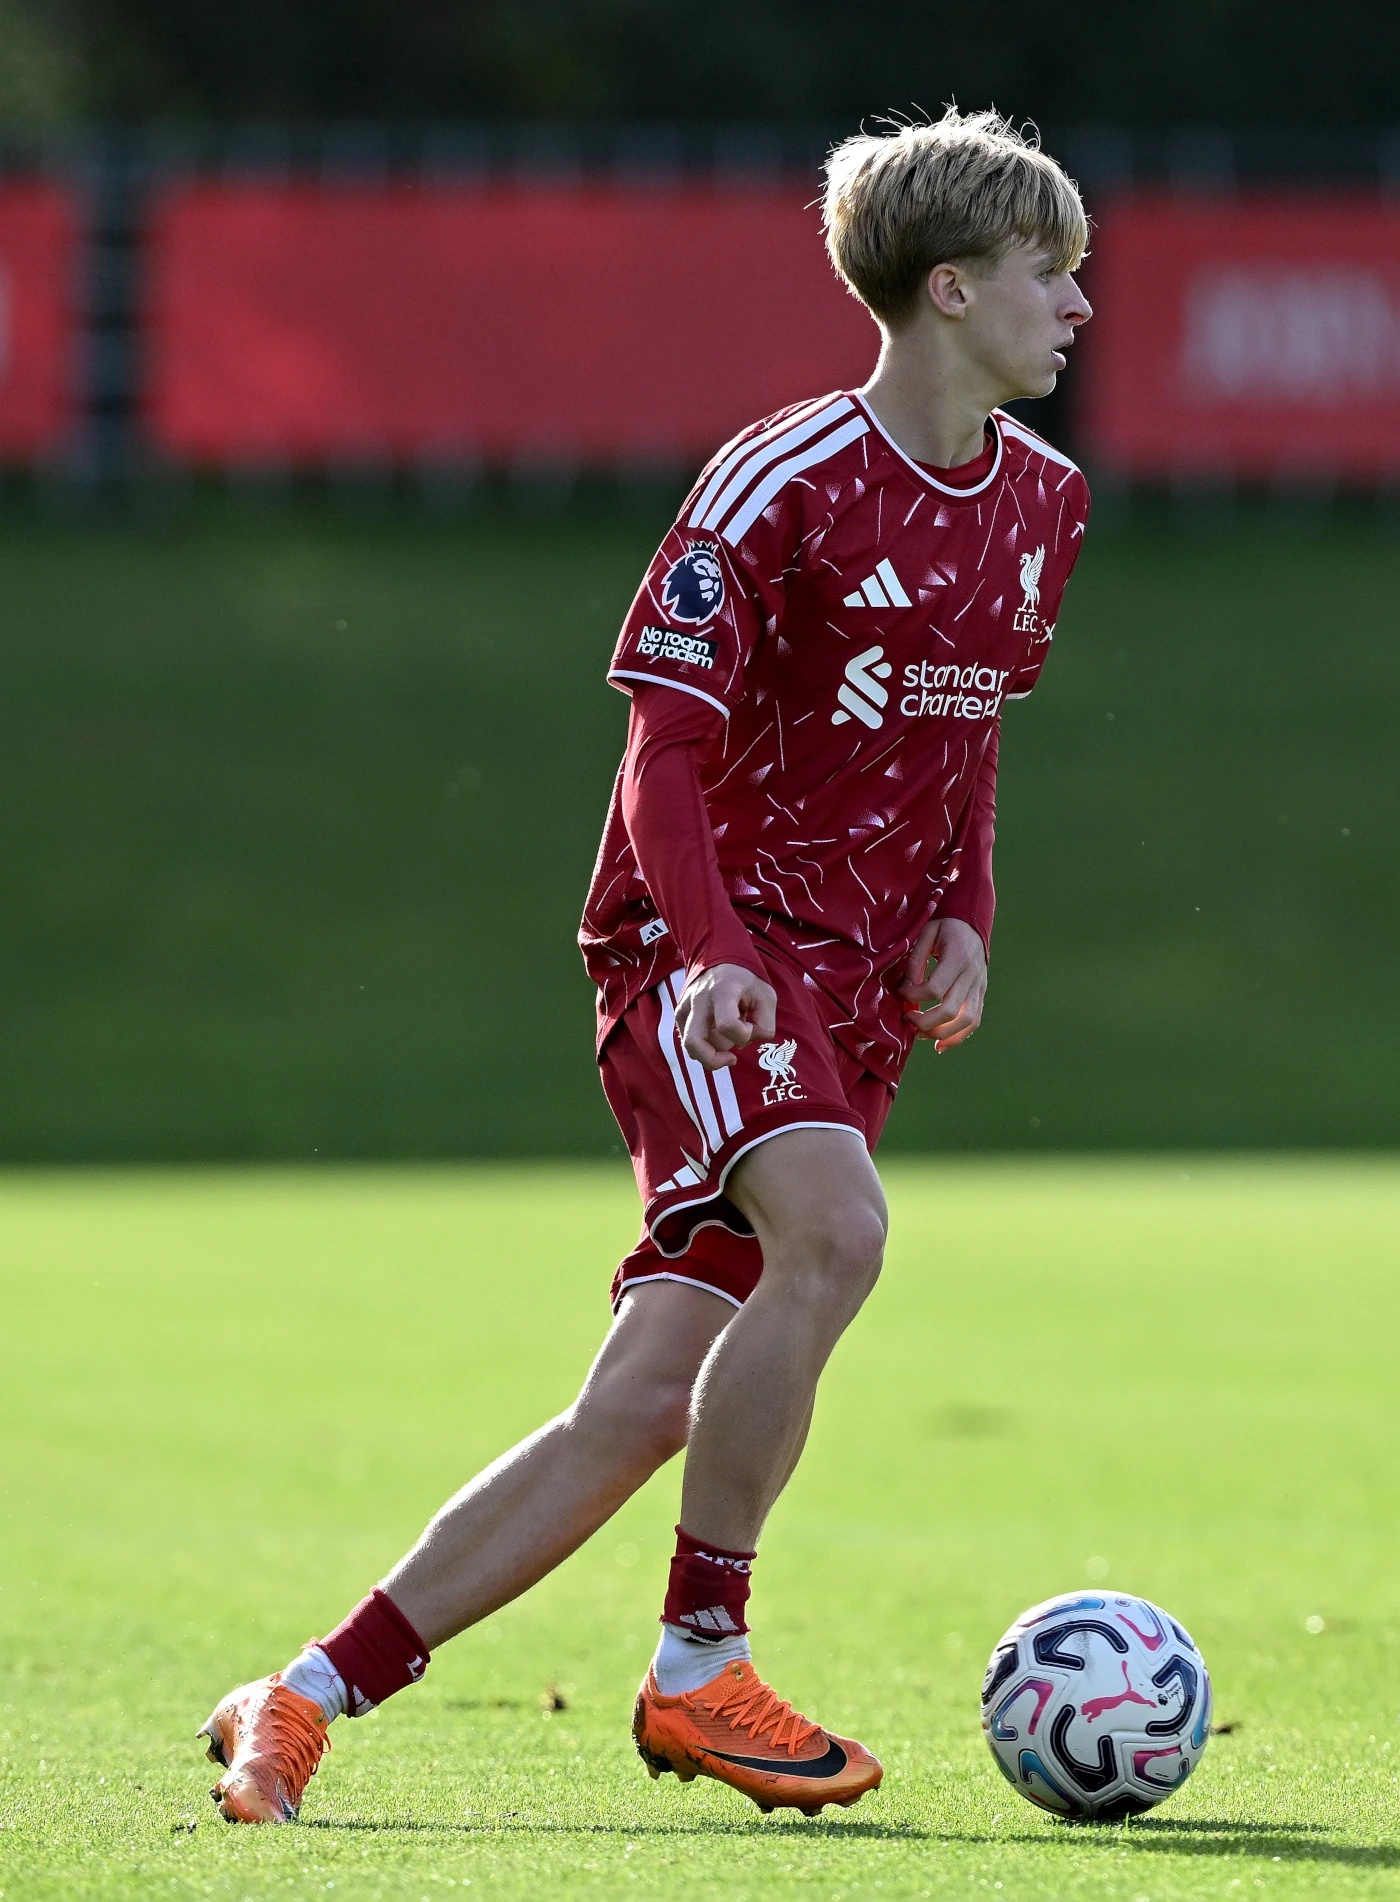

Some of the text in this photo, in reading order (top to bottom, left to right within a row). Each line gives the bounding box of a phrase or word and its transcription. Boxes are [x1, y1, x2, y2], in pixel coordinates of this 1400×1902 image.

[640, 625, 710, 655] No room
[659, 644, 714, 670] racism
[902, 659, 1010, 693] standar
[761, 1084, 808, 1107] L.F.C.
